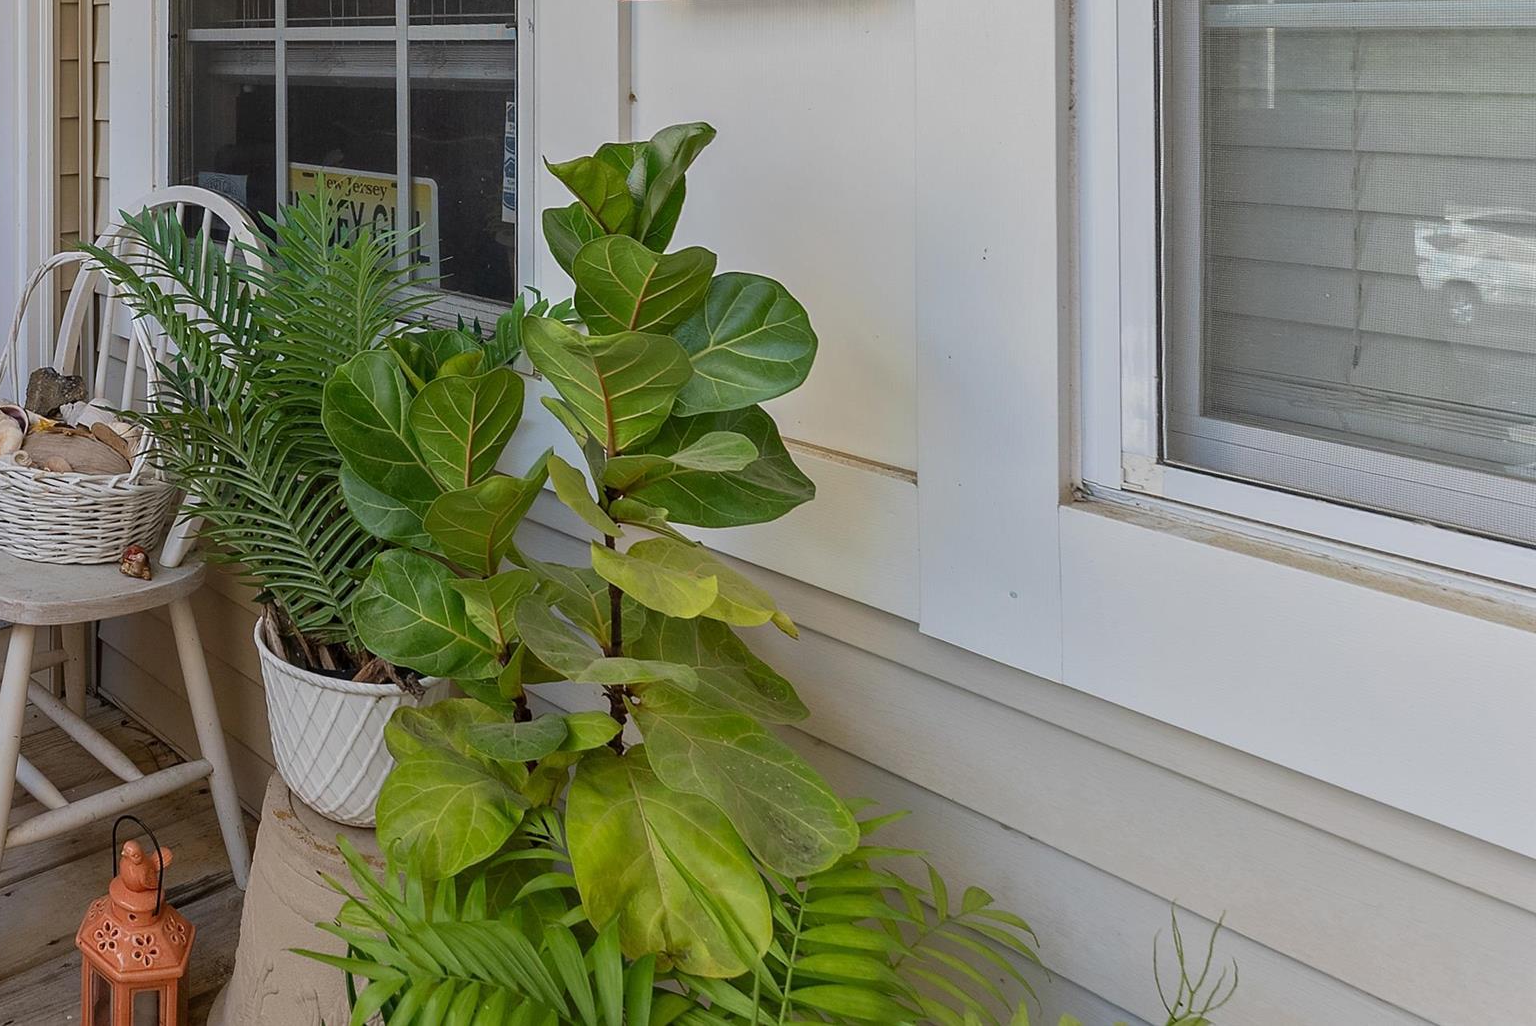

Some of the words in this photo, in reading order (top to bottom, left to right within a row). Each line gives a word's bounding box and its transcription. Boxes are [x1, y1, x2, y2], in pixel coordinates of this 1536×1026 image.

[316, 172, 344, 191] ew
[344, 176, 388, 202] Jersey
[372, 204, 431, 265] GIL
